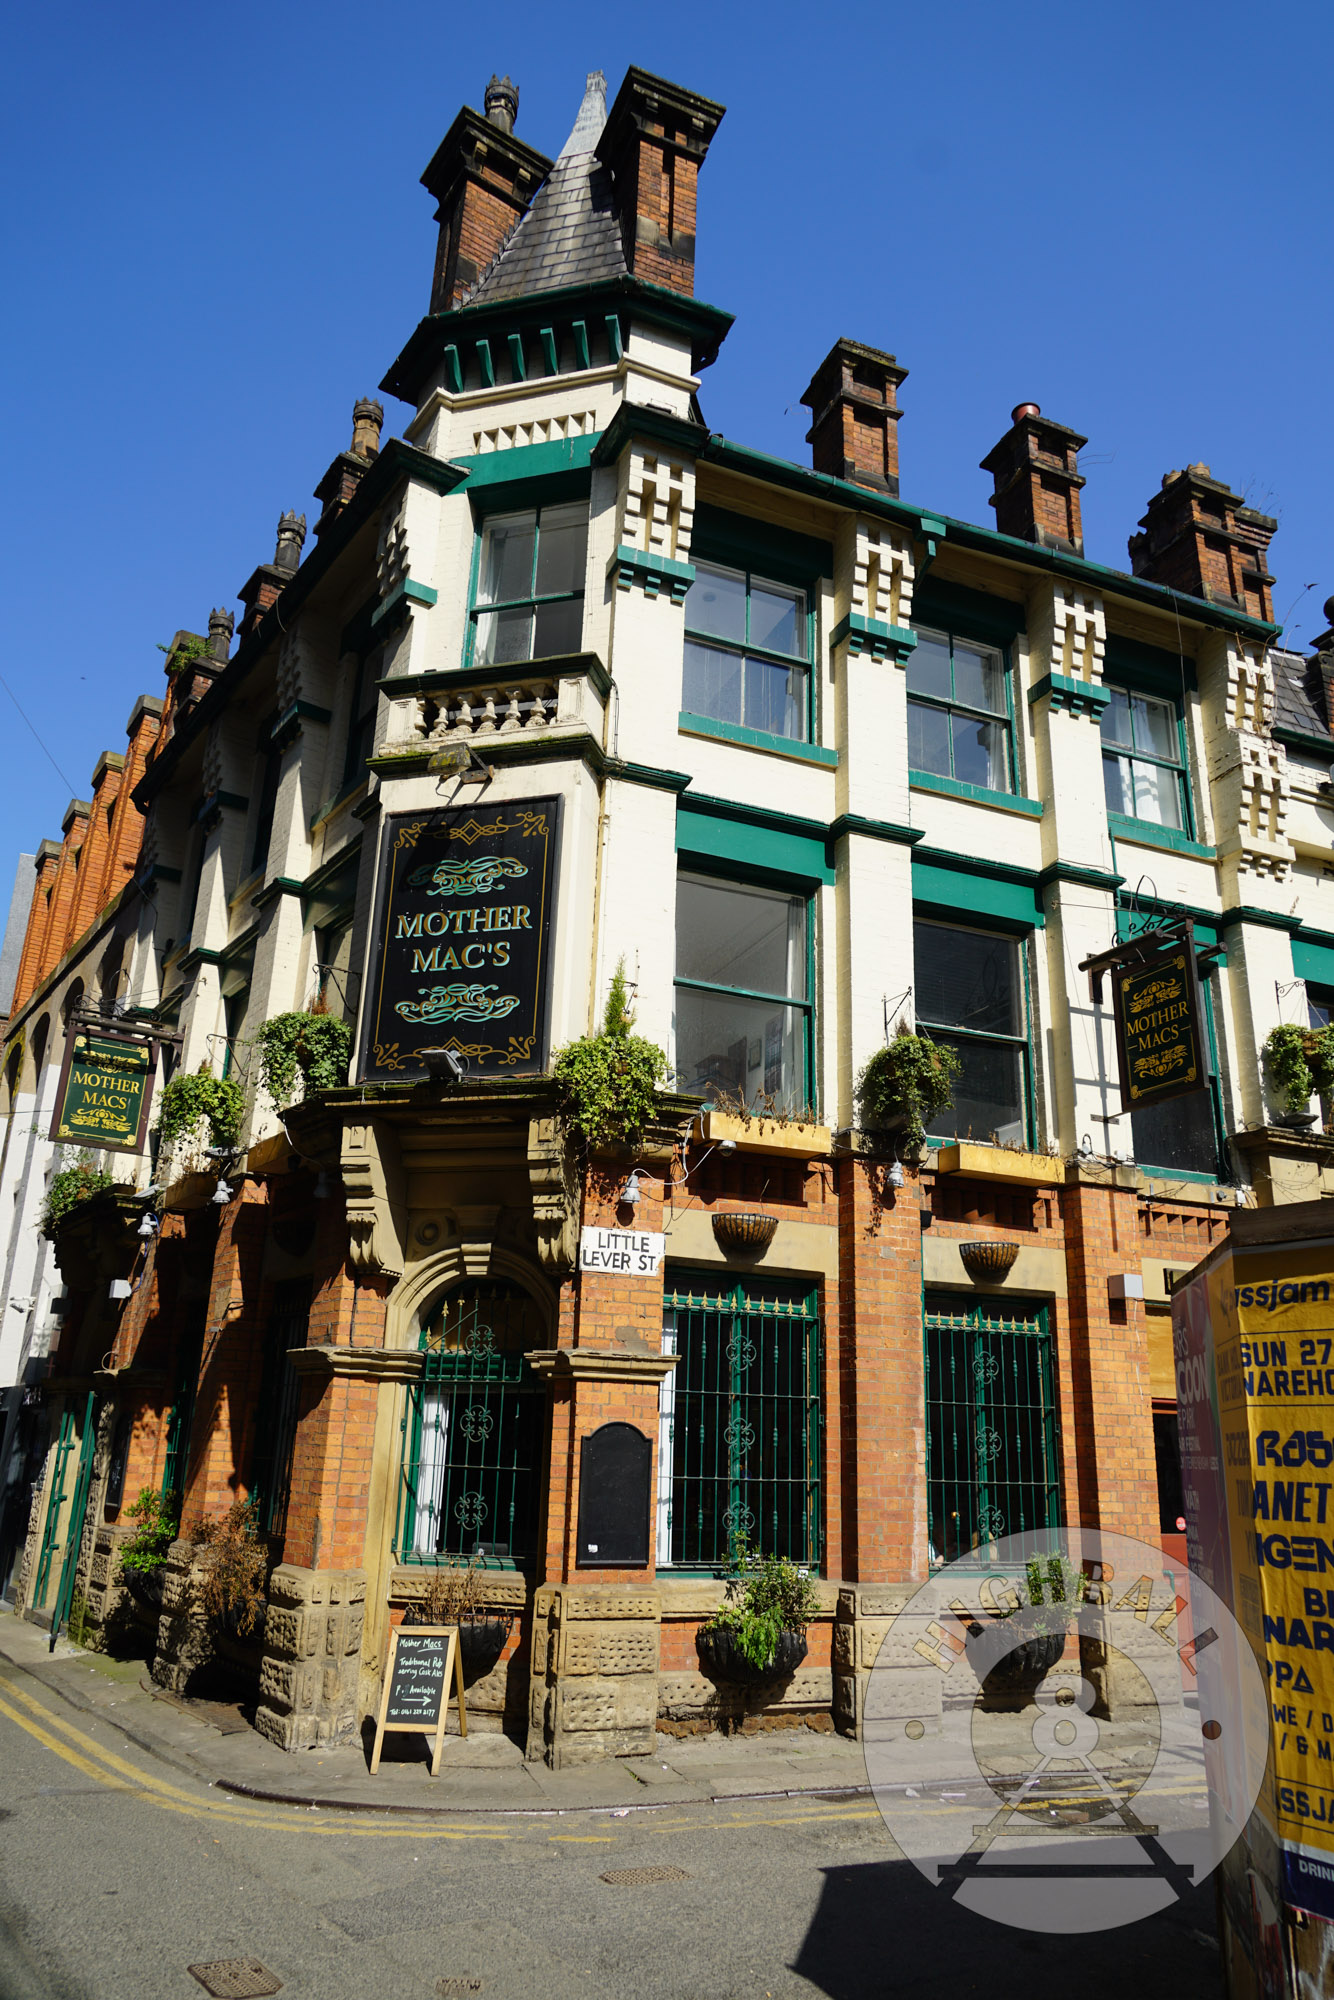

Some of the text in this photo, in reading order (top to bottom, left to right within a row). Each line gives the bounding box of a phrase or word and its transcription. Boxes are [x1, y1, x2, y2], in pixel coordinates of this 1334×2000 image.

[394, 904, 533, 938] MOTHER
[410, 941, 511, 973] MAC'S
[1126, 1001, 1190, 1037] MOTHER
[1137, 1025, 1179, 1052] MACS
[73, 1071, 140, 1094] MOTHER
[82, 1091, 127, 1110] MACS
[598, 1231, 650, 1253] LITTLE
[582, 1249, 631, 1270] LEVER
[1241, 1338, 1332, 1367] SUN 27
[399, 1638, 442, 1648] Mother Macs
[399, 1656, 443, 1669] Traditional Pub
[409, 1685, 437, 1695] Available
